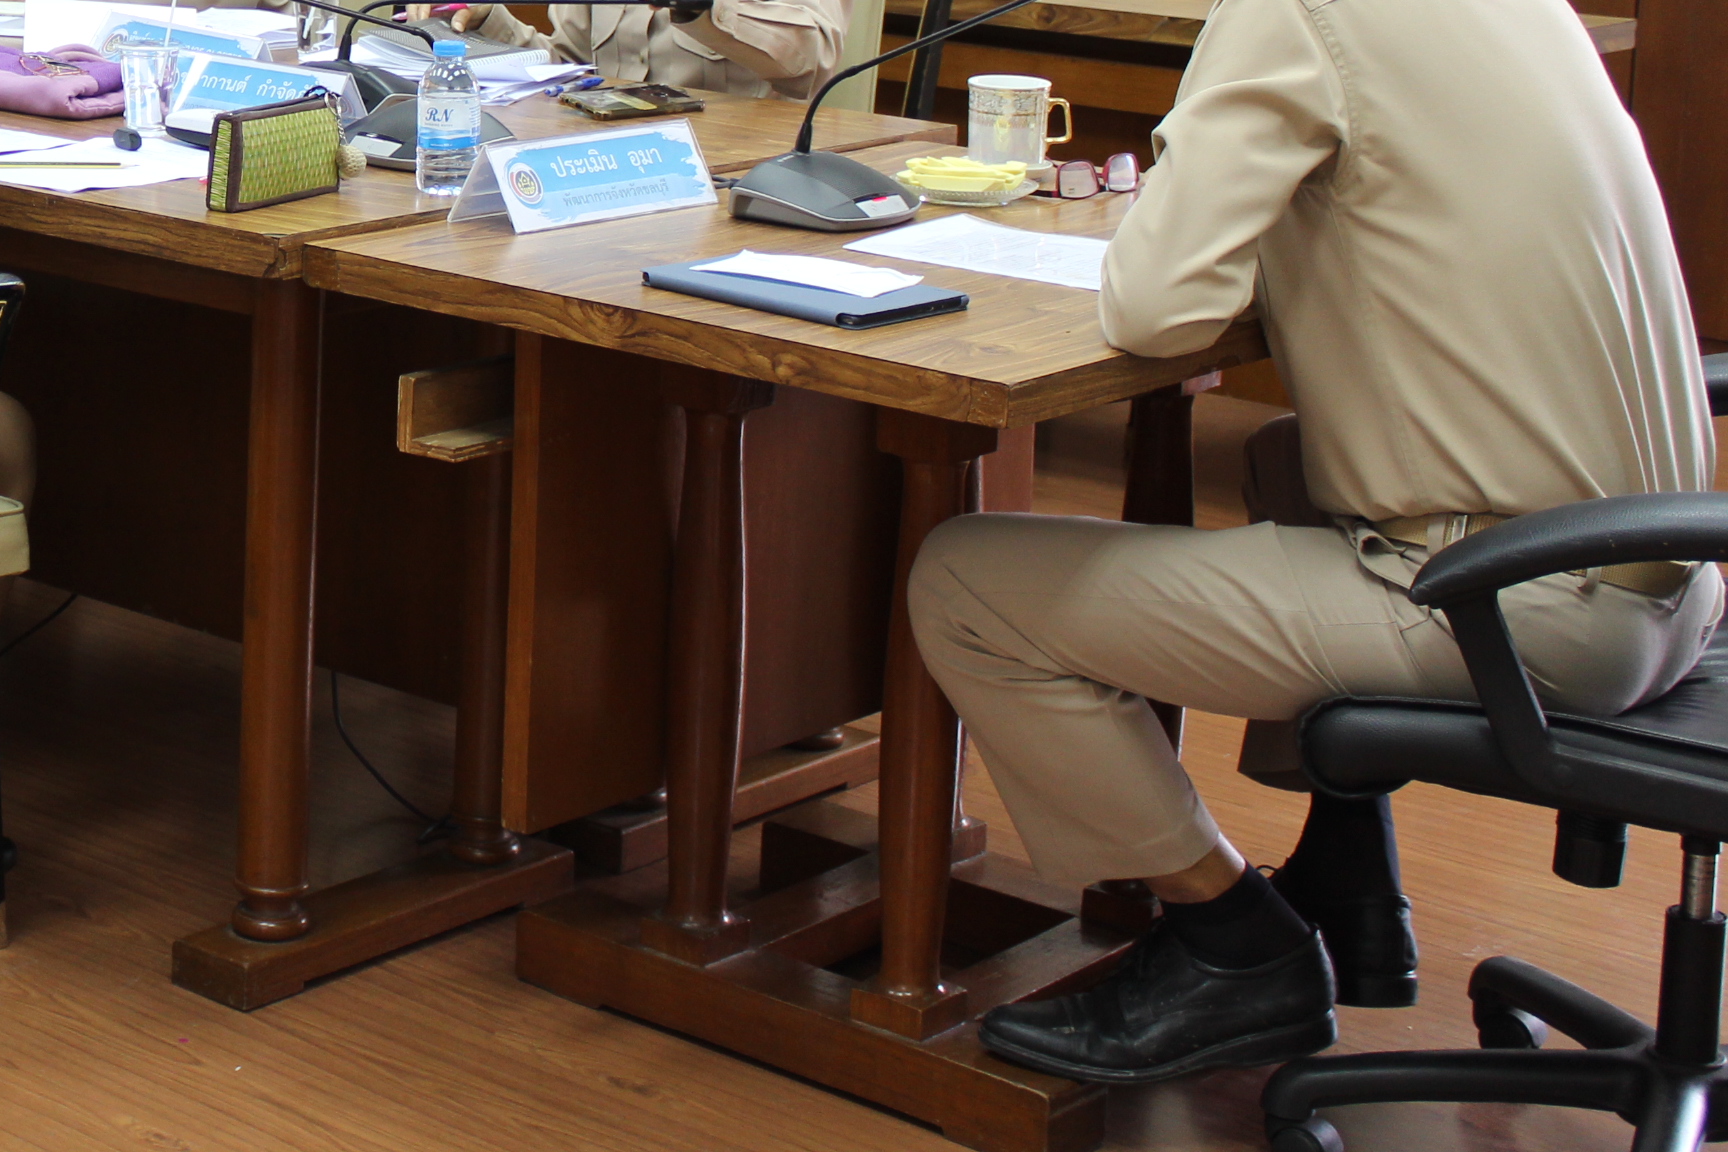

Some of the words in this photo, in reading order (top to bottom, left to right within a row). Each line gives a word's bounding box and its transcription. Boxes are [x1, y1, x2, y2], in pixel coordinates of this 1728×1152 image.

[550, 149, 618, 178] ประเมิน
[627, 146, 663, 174] อุมา
